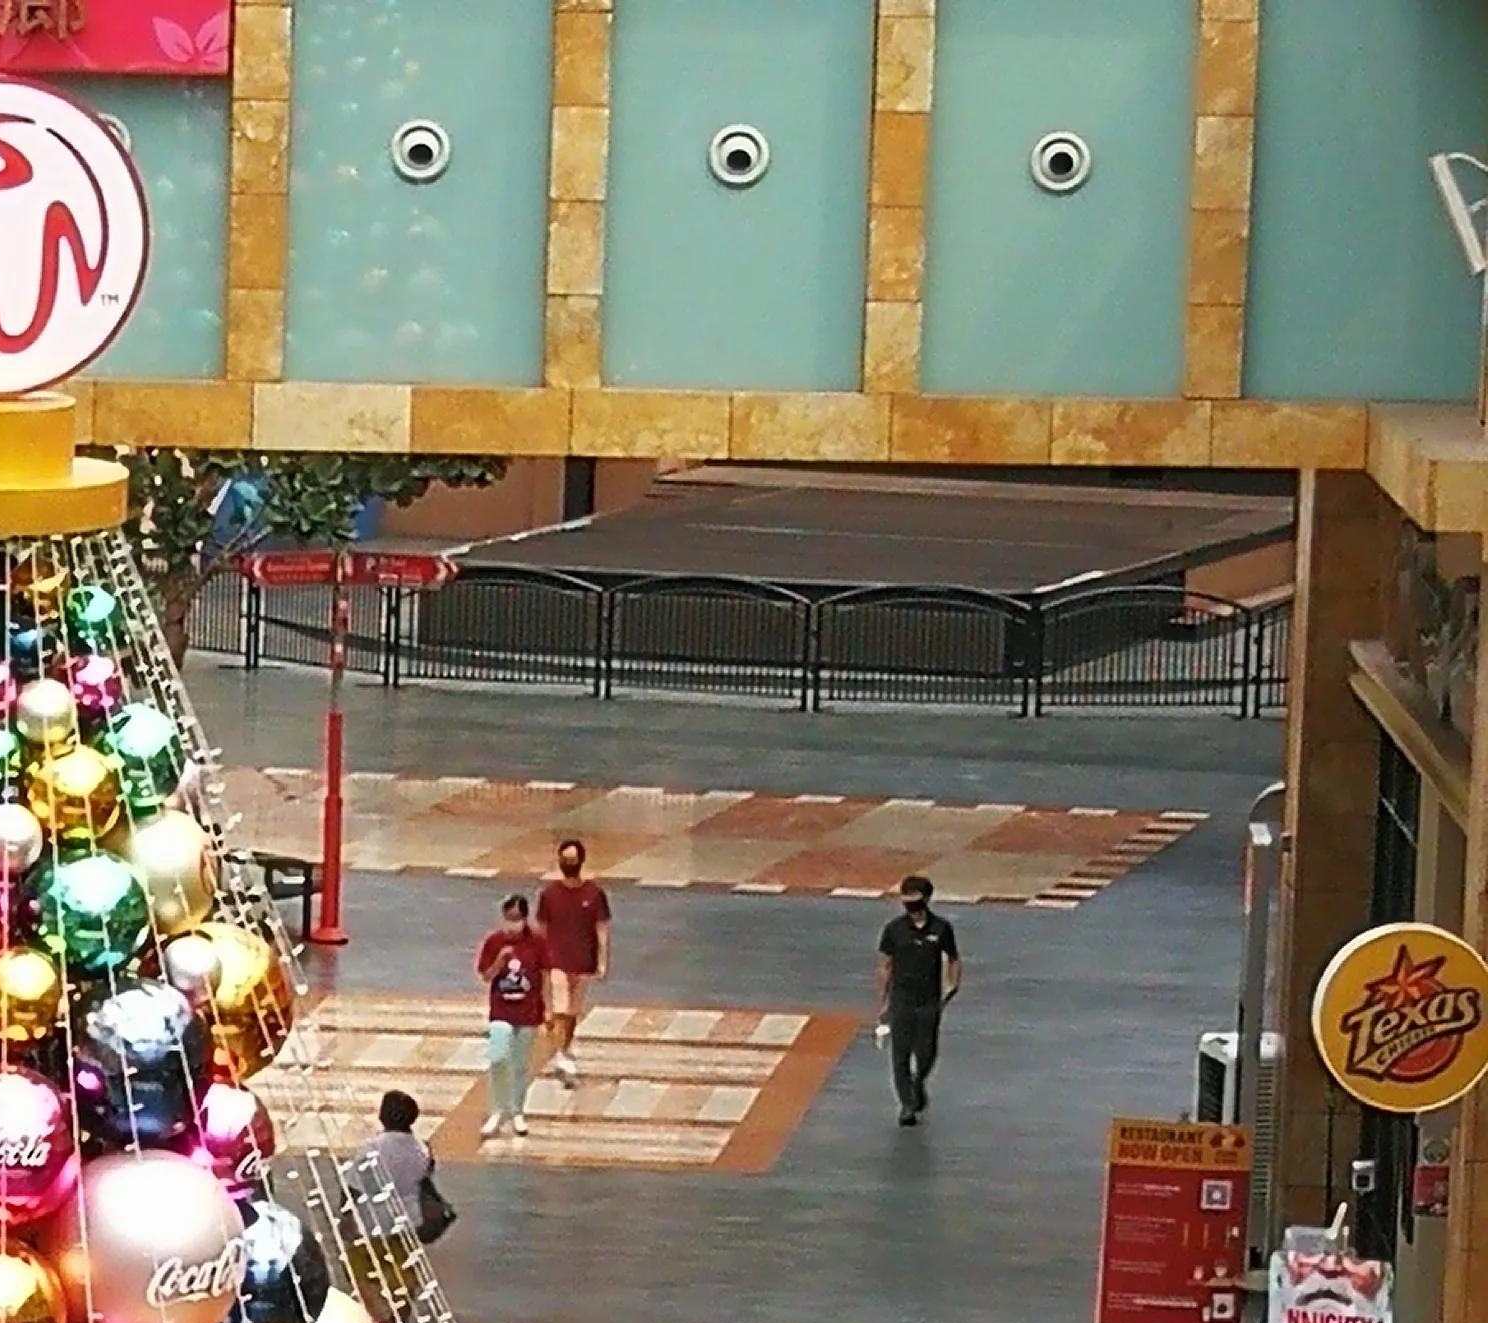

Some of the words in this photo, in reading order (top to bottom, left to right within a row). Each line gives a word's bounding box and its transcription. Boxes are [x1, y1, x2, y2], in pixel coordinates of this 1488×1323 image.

[1347, 990, 1476, 1064] Texas
[1120, 1126, 1205, 1144] RESTAURANT
[1118, 1142, 1159, 1161] NOW
[1161, 1145, 1203, 1162] OPEN
